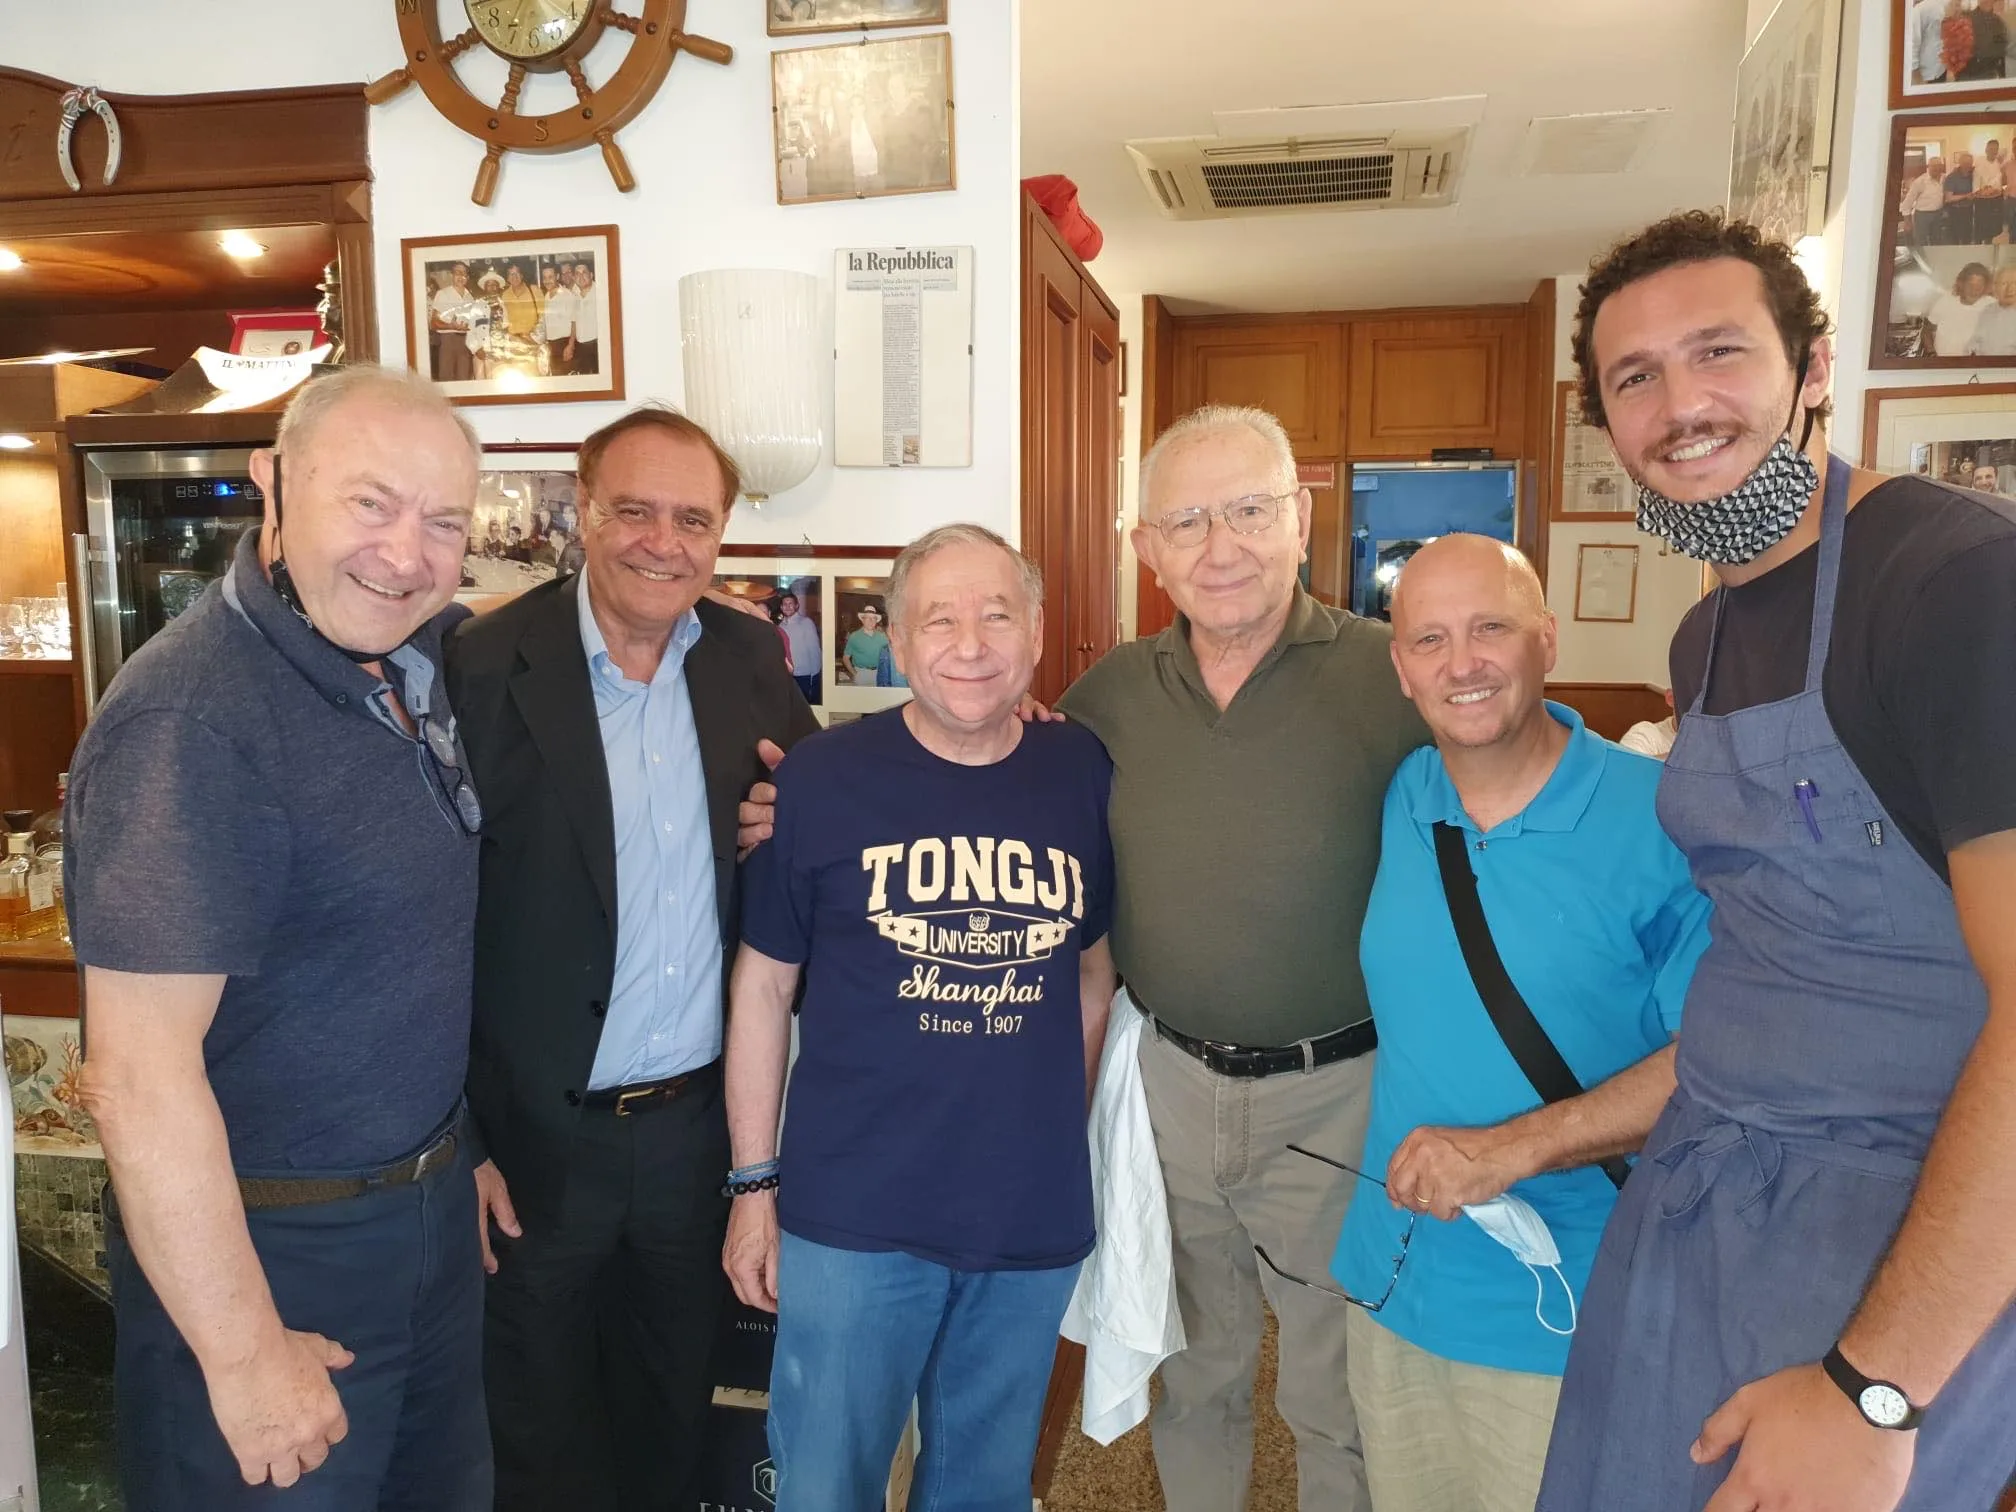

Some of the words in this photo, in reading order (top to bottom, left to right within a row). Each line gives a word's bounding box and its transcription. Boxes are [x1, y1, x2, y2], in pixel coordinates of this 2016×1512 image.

[488, 6, 500, 28] 8
[507, 23, 519, 45] 7
[528, 27, 541, 50] 6
[550, 18, 563, 42] 5
[534, 119, 550, 143] S
[849, 252, 863, 271] la
[867, 251, 954, 274] Repubblica
[245, 360, 297, 369] MATTIN
[862, 836, 1084, 919] TONGJI
[929, 926, 1025, 957] UNIVERSITY
[898, 964, 1043, 1015] Shanghai
[919, 1013, 973, 1034] Since
[985, 1015, 1023, 1035] 1907
[735, 1320, 769, 1332] ALOIS
